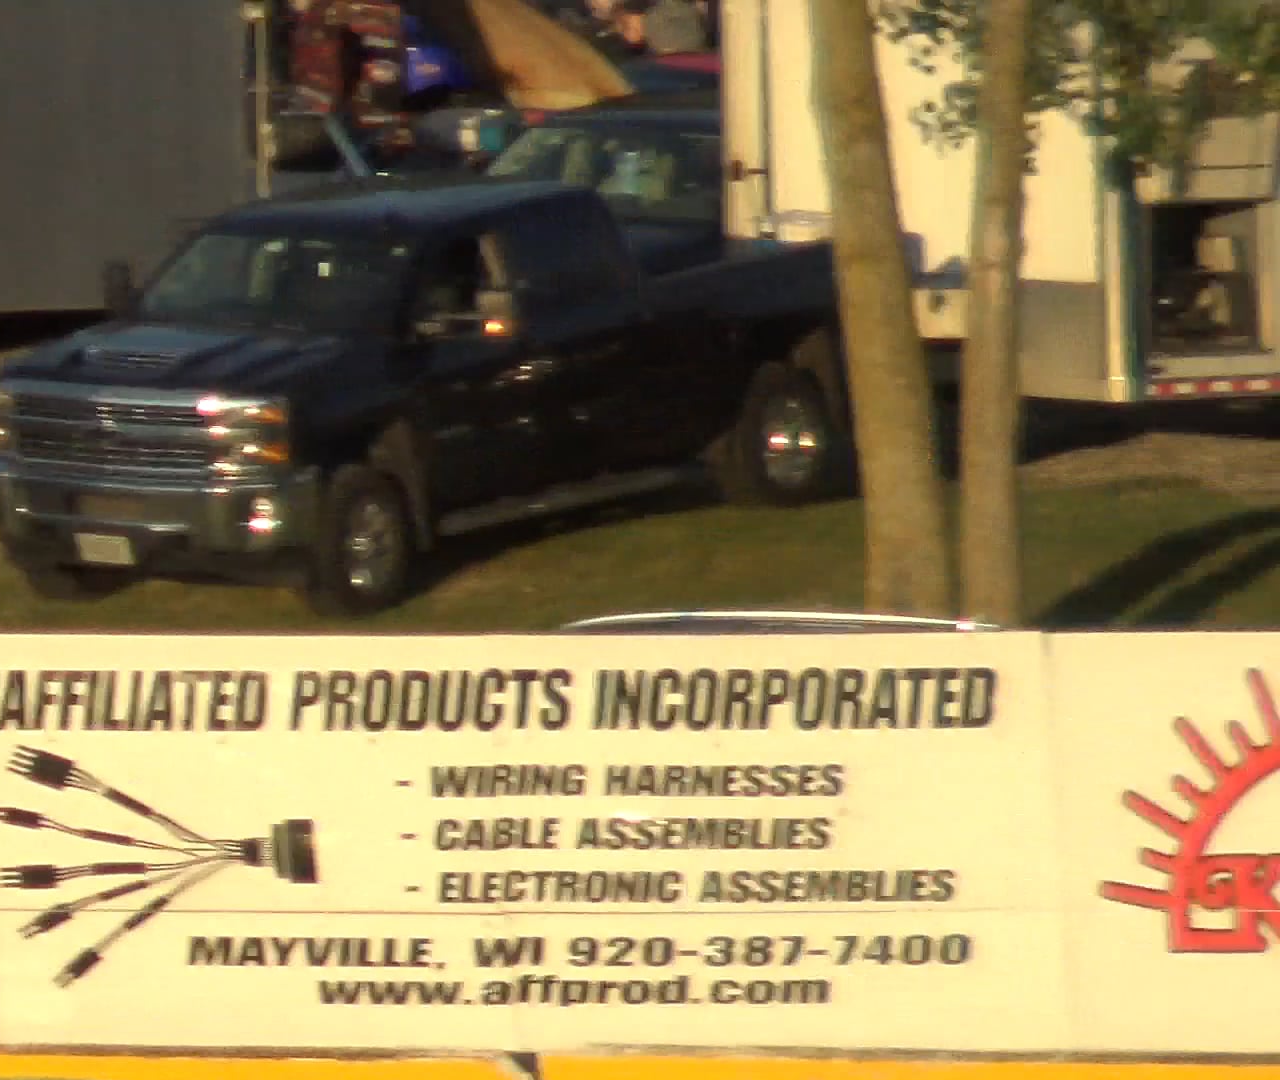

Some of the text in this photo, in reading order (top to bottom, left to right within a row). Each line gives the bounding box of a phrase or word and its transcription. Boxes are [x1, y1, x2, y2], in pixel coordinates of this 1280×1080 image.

[288, 667, 572, 732] PRODUCTS
[592, 666, 998, 731] INCORPORATED
[430, 763, 846, 798] WIRING HARNESSES
[434, 816, 834, 851] CABLE ASSEMBLIES
[439, 868, 956, 903] ELECTRONIC ASSEMBLIES
[187, 933, 971, 969] MAYVILLE, WI 920-387-7400
[318, 973, 833, 1007] www.affprod.com
